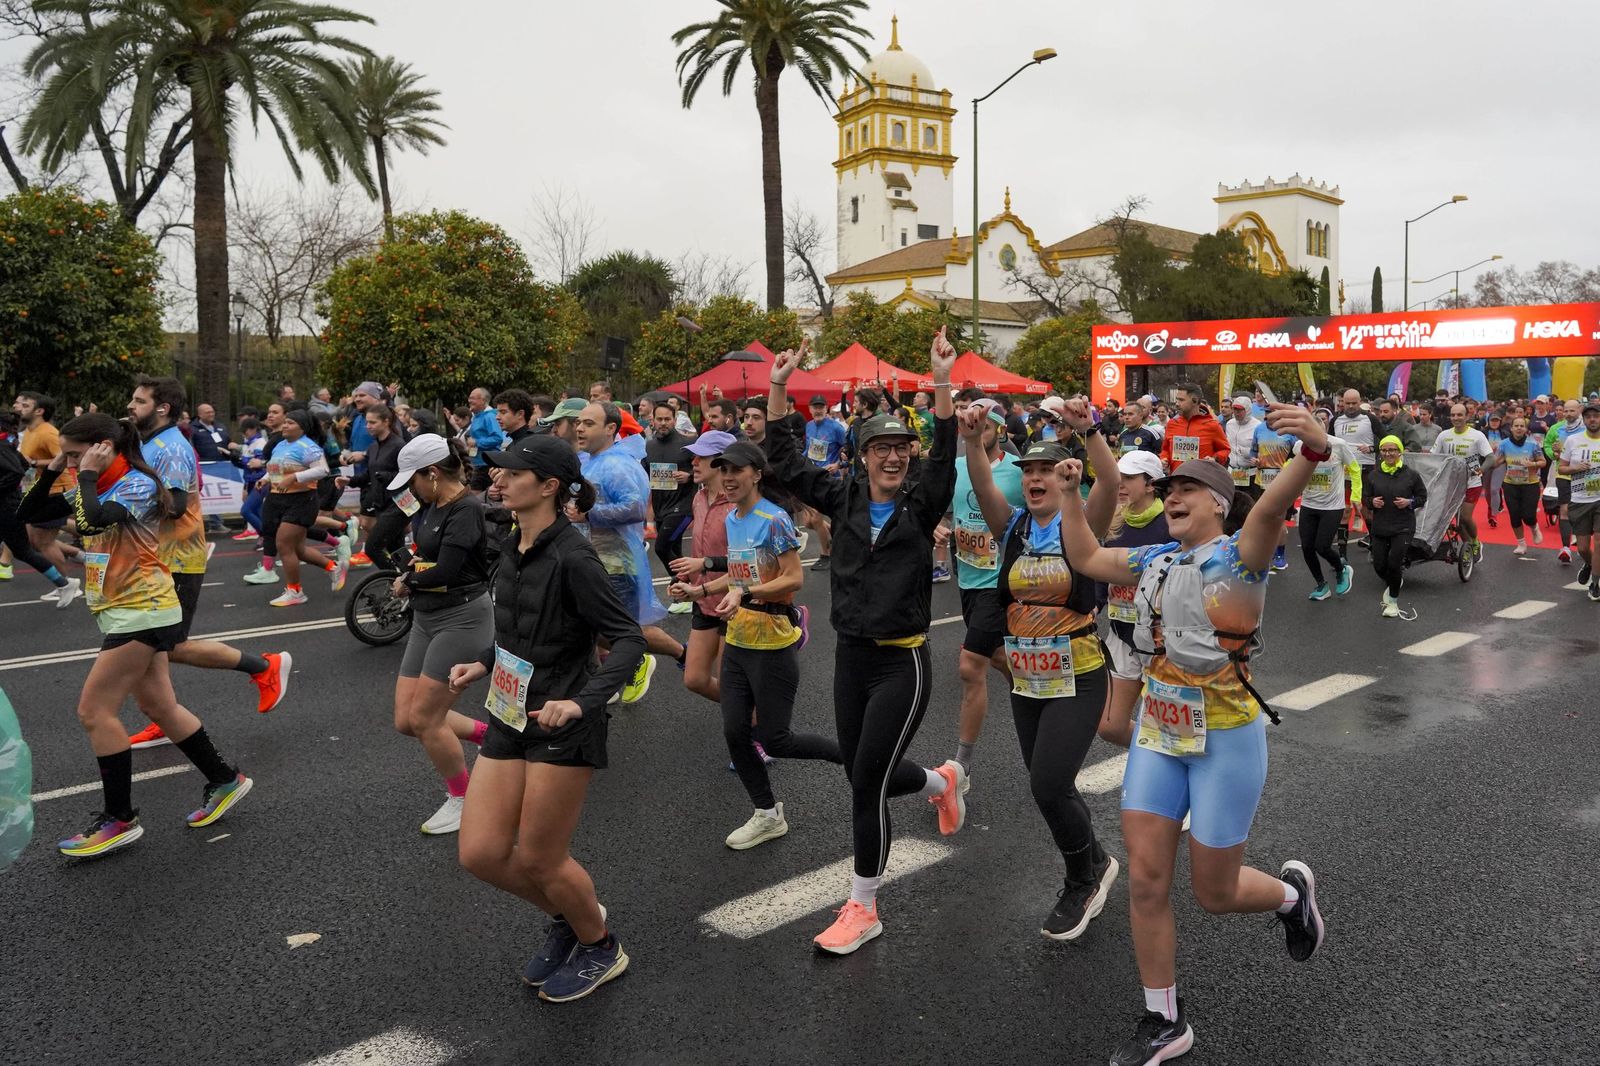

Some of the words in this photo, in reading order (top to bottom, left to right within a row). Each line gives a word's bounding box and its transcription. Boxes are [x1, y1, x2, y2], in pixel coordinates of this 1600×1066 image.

[1522, 320, 1582, 339] HOKA
[1247, 332, 1292, 349] HOKA
[1174, 442, 1195, 451] 19209
[652, 469, 673, 479] 20553
[1311, 474, 1329, 482] 0570
[959, 530, 985, 548] 5060
[1021, 563, 1066, 578] MARA
[1110, 585, 1138, 601] 1985
[1202, 577, 1232, 598] ON
[1206, 594, 1221, 609] A
[1011, 651, 1061, 672] 21132
[494, 665, 520, 699] 2651
[1144, 694, 1191, 726] 21231
